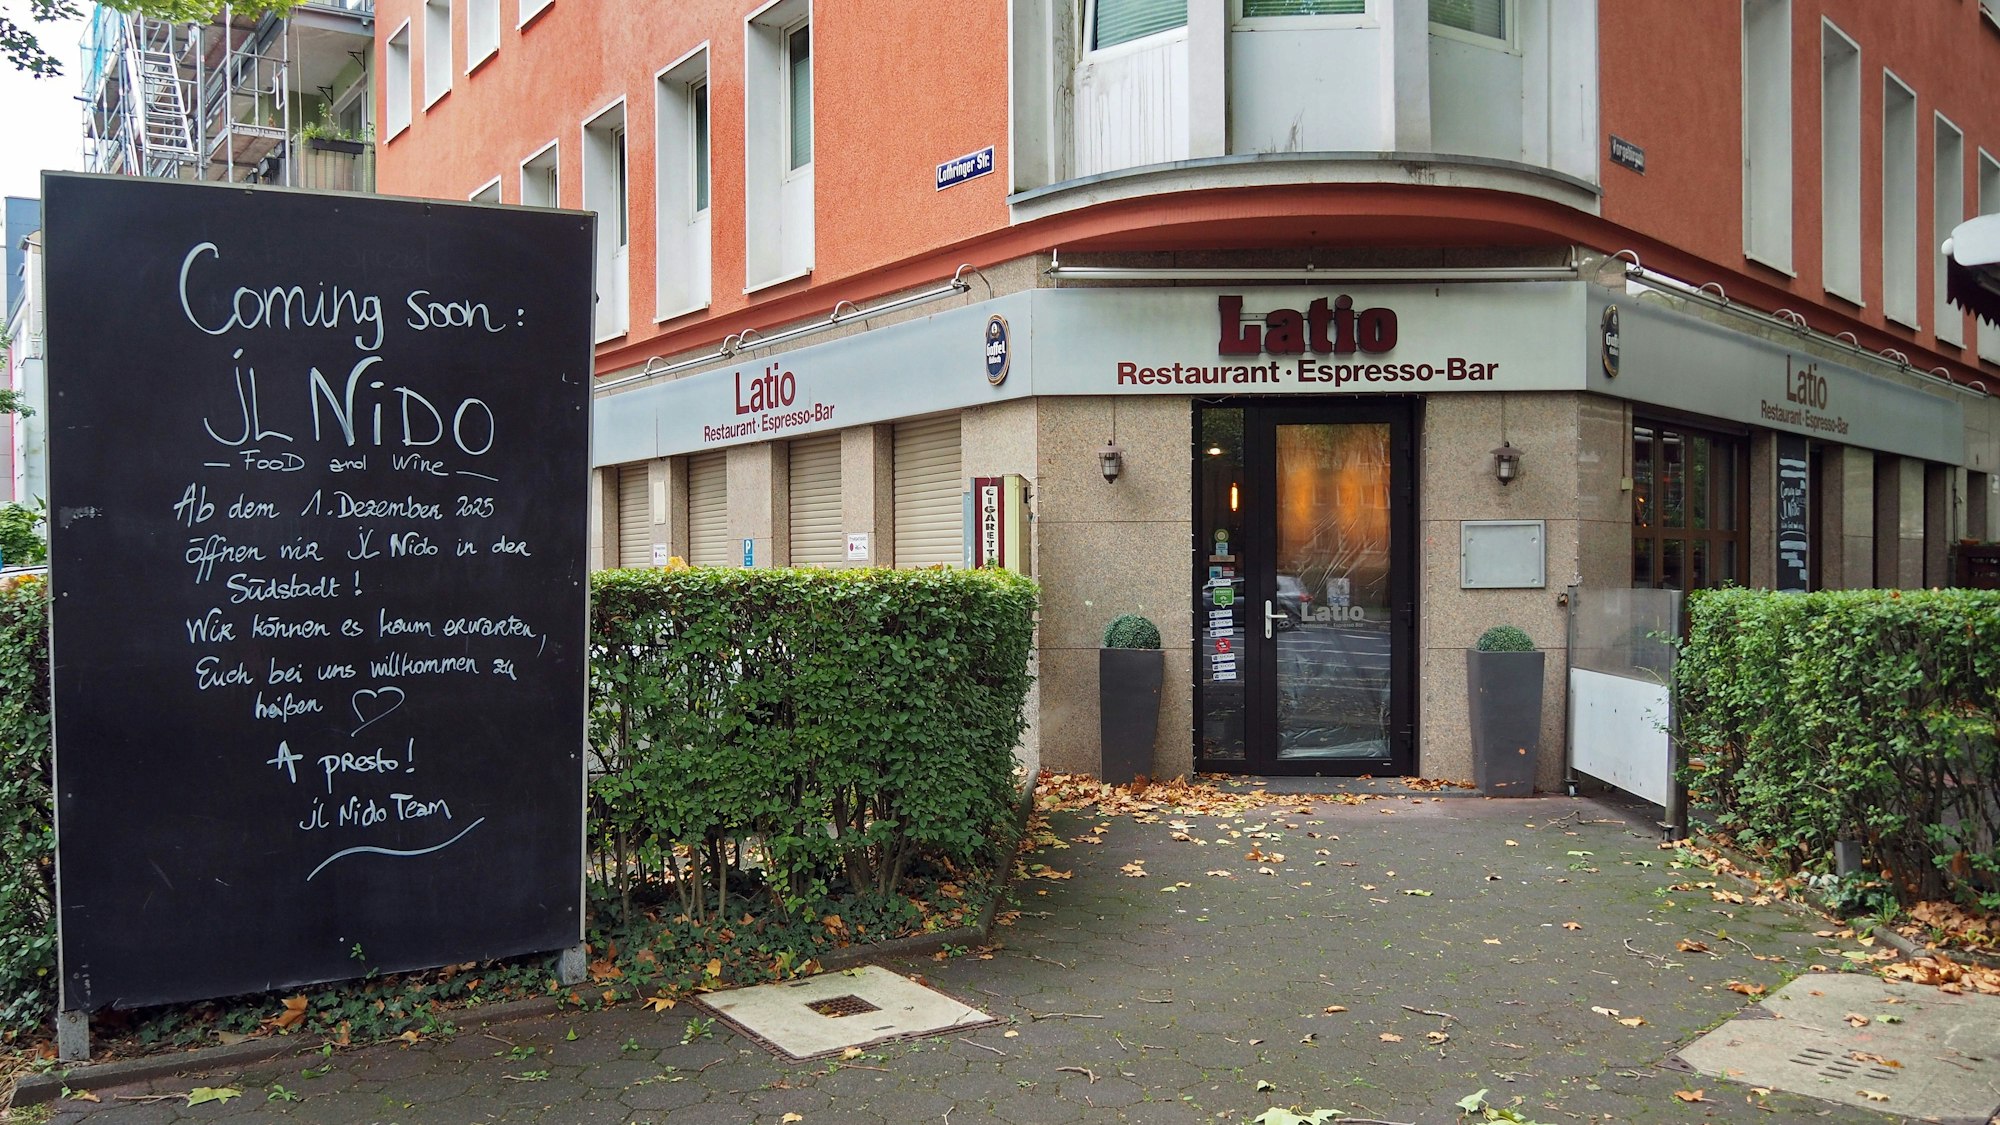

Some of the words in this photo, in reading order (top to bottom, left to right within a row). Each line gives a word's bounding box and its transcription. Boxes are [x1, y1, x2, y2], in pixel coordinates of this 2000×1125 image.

[938, 159, 976, 183] Lothringer
[976, 152, 990, 170] Str.
[179, 241, 384, 350] Coming
[1218, 294, 1398, 355] Latio
[735, 362, 796, 416] Latio
[1117, 360, 1280, 385] Restaurant
[1298, 357, 1499, 387] Espresso-Bar
[1786, 354, 1828, 410] Latio
[704, 417, 757, 443] Restaurant
[761, 402, 835, 434] Espresso-Bar
[1760, 399, 1803, 426] Restaurant
[1805, 409, 1849, 435] Espresso-Bar
[329, 454, 367, 473] and
[392, 453, 449, 476] Wine
[173, 482, 215, 527] Ab
[228, 492, 281, 519] dem
[456, 495, 495, 518] 2025
[185, 534, 267, 584] öffnen
[390, 531, 439, 558] Nido
[456, 537, 478, 558] in
[491, 534, 532, 557] der
[745, 540, 752, 554] P
[186, 607, 237, 644] Wir
[252, 613, 331, 639] können
[340, 618, 364, 637] es
[379, 607, 436, 638] kaum
[1300, 601, 1365, 621] Latio
[195, 656, 254, 690] Euch
[268, 657, 303, 685] bei
[317, 664, 357, 681] uns
[370, 651, 480, 679] willkommen
[492, 658, 518, 681] zu
[255, 691, 324, 723] heißen
[266, 740, 304, 784] A
[339, 795, 387, 827] Nido
[389, 793, 452, 821] Team
